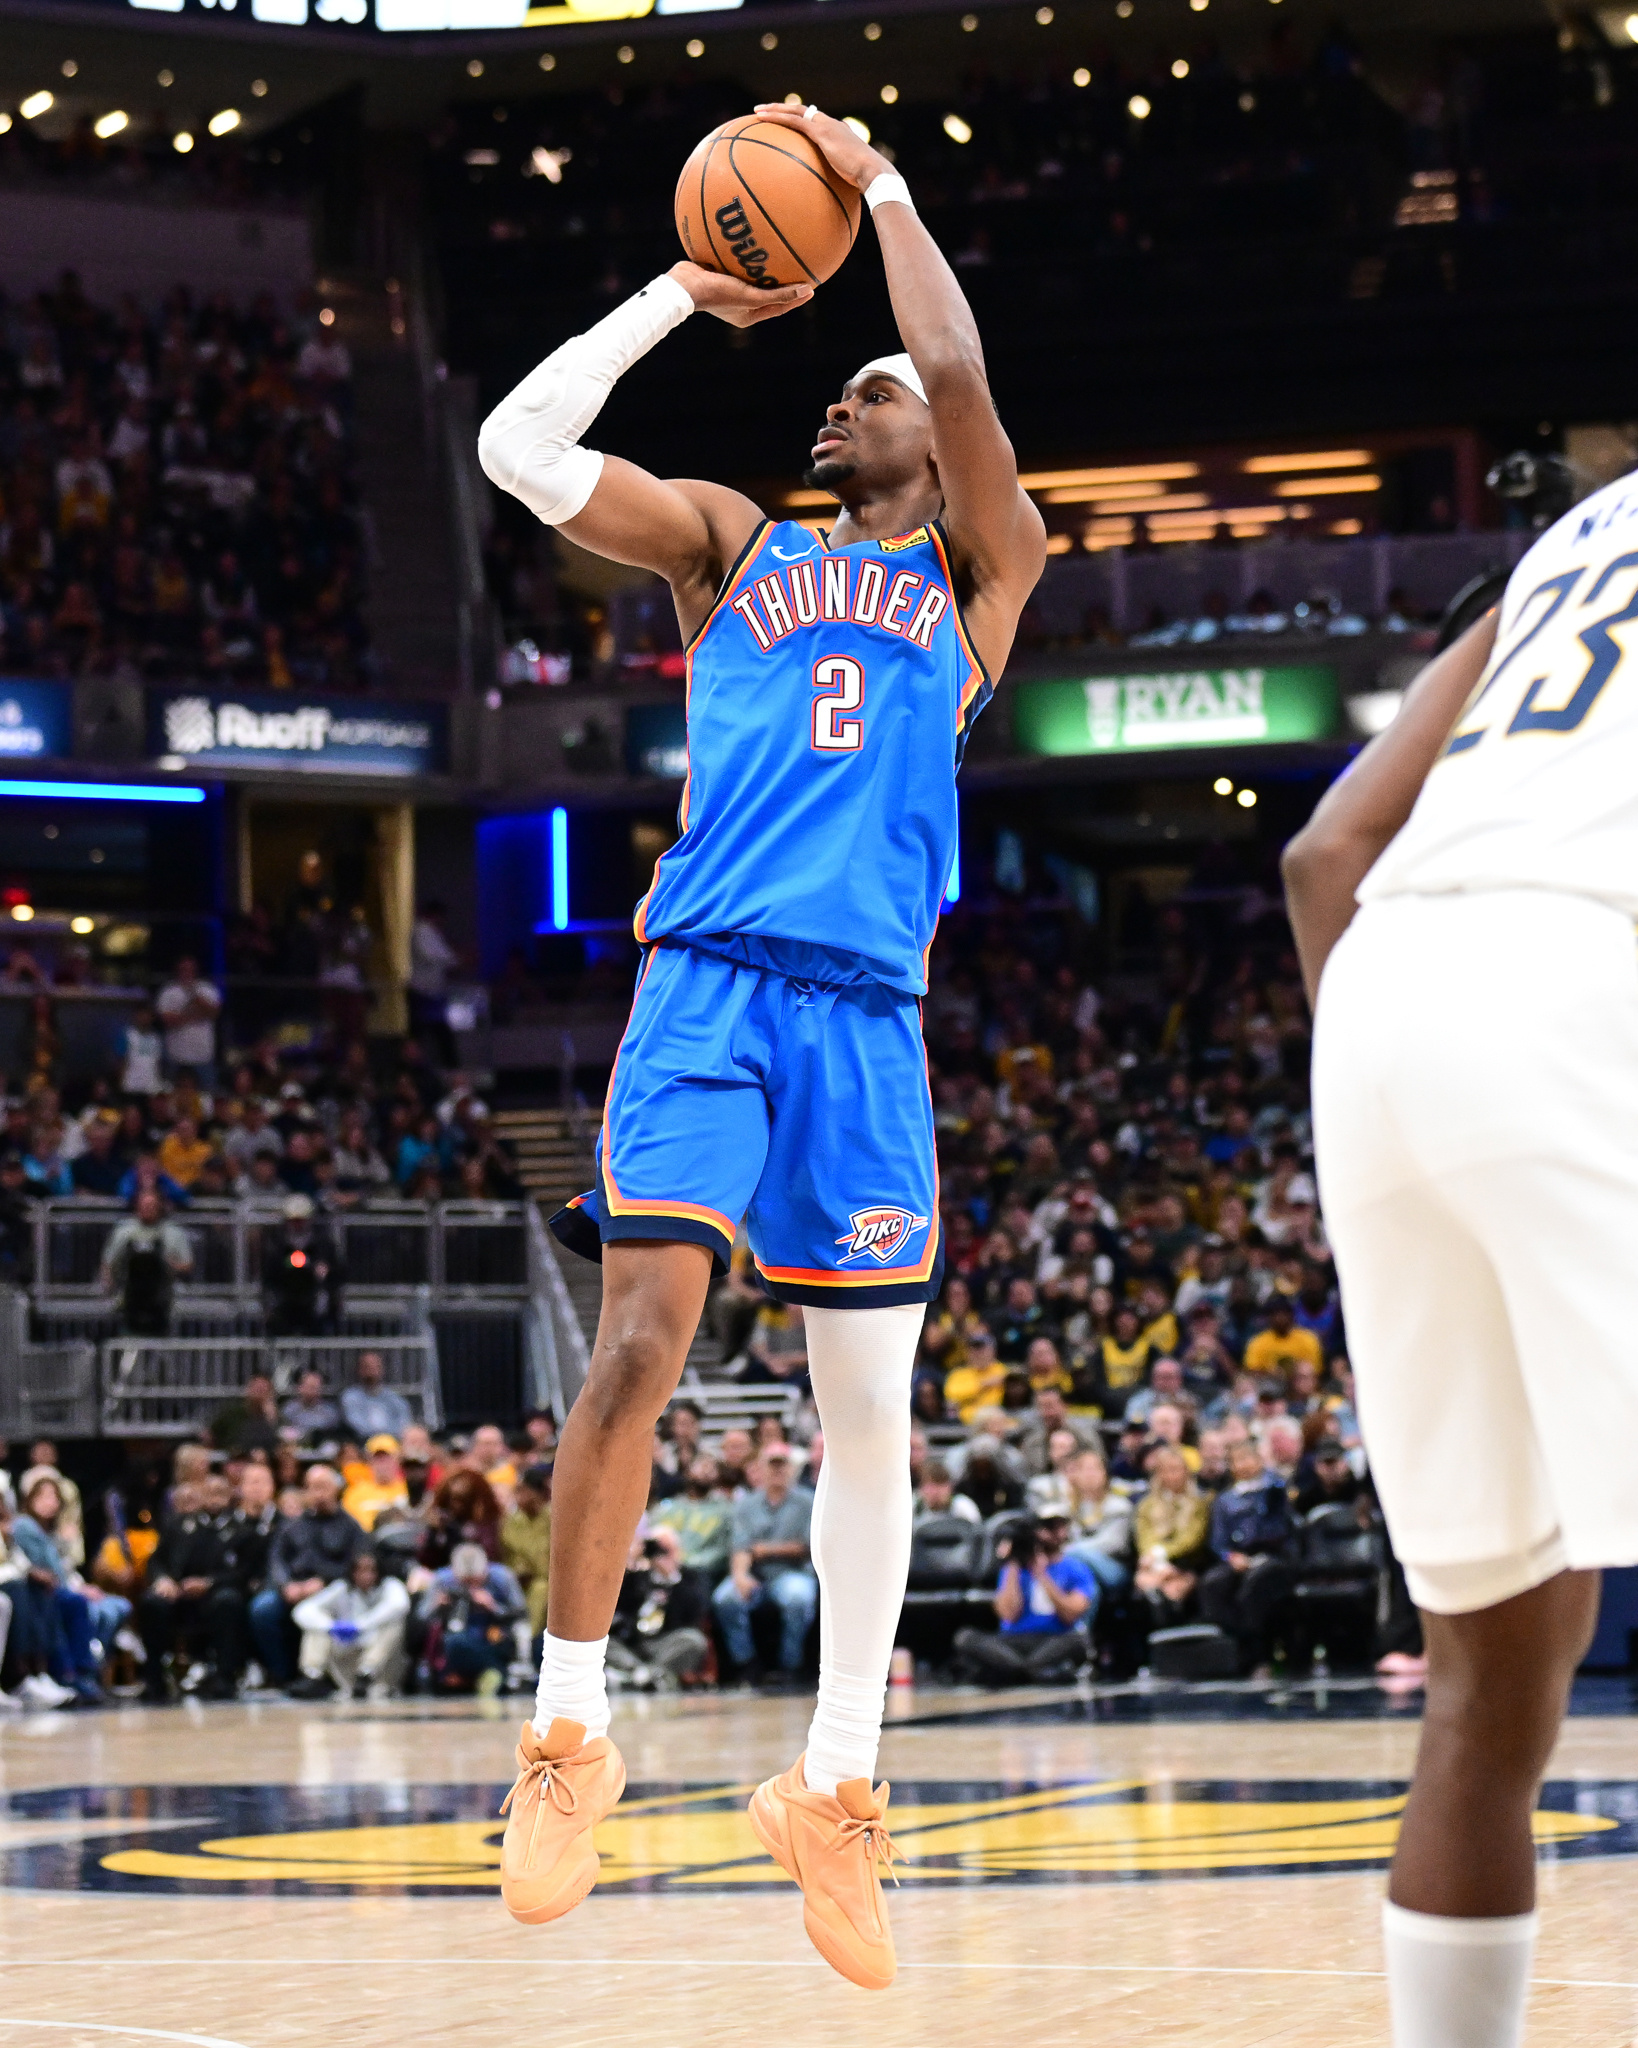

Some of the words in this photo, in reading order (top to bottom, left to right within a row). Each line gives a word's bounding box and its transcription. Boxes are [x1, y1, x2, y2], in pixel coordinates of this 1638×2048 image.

[715, 195, 779, 290] Wilso
[729, 556, 949, 654] THUNDER
[1442, 547, 1638, 757] 23
[216, 703, 331, 750] Ruoff
[811, 653, 865, 751] 2
[1123, 671, 1265, 723] RYAN
[850, 1216, 902, 1253] OKC
